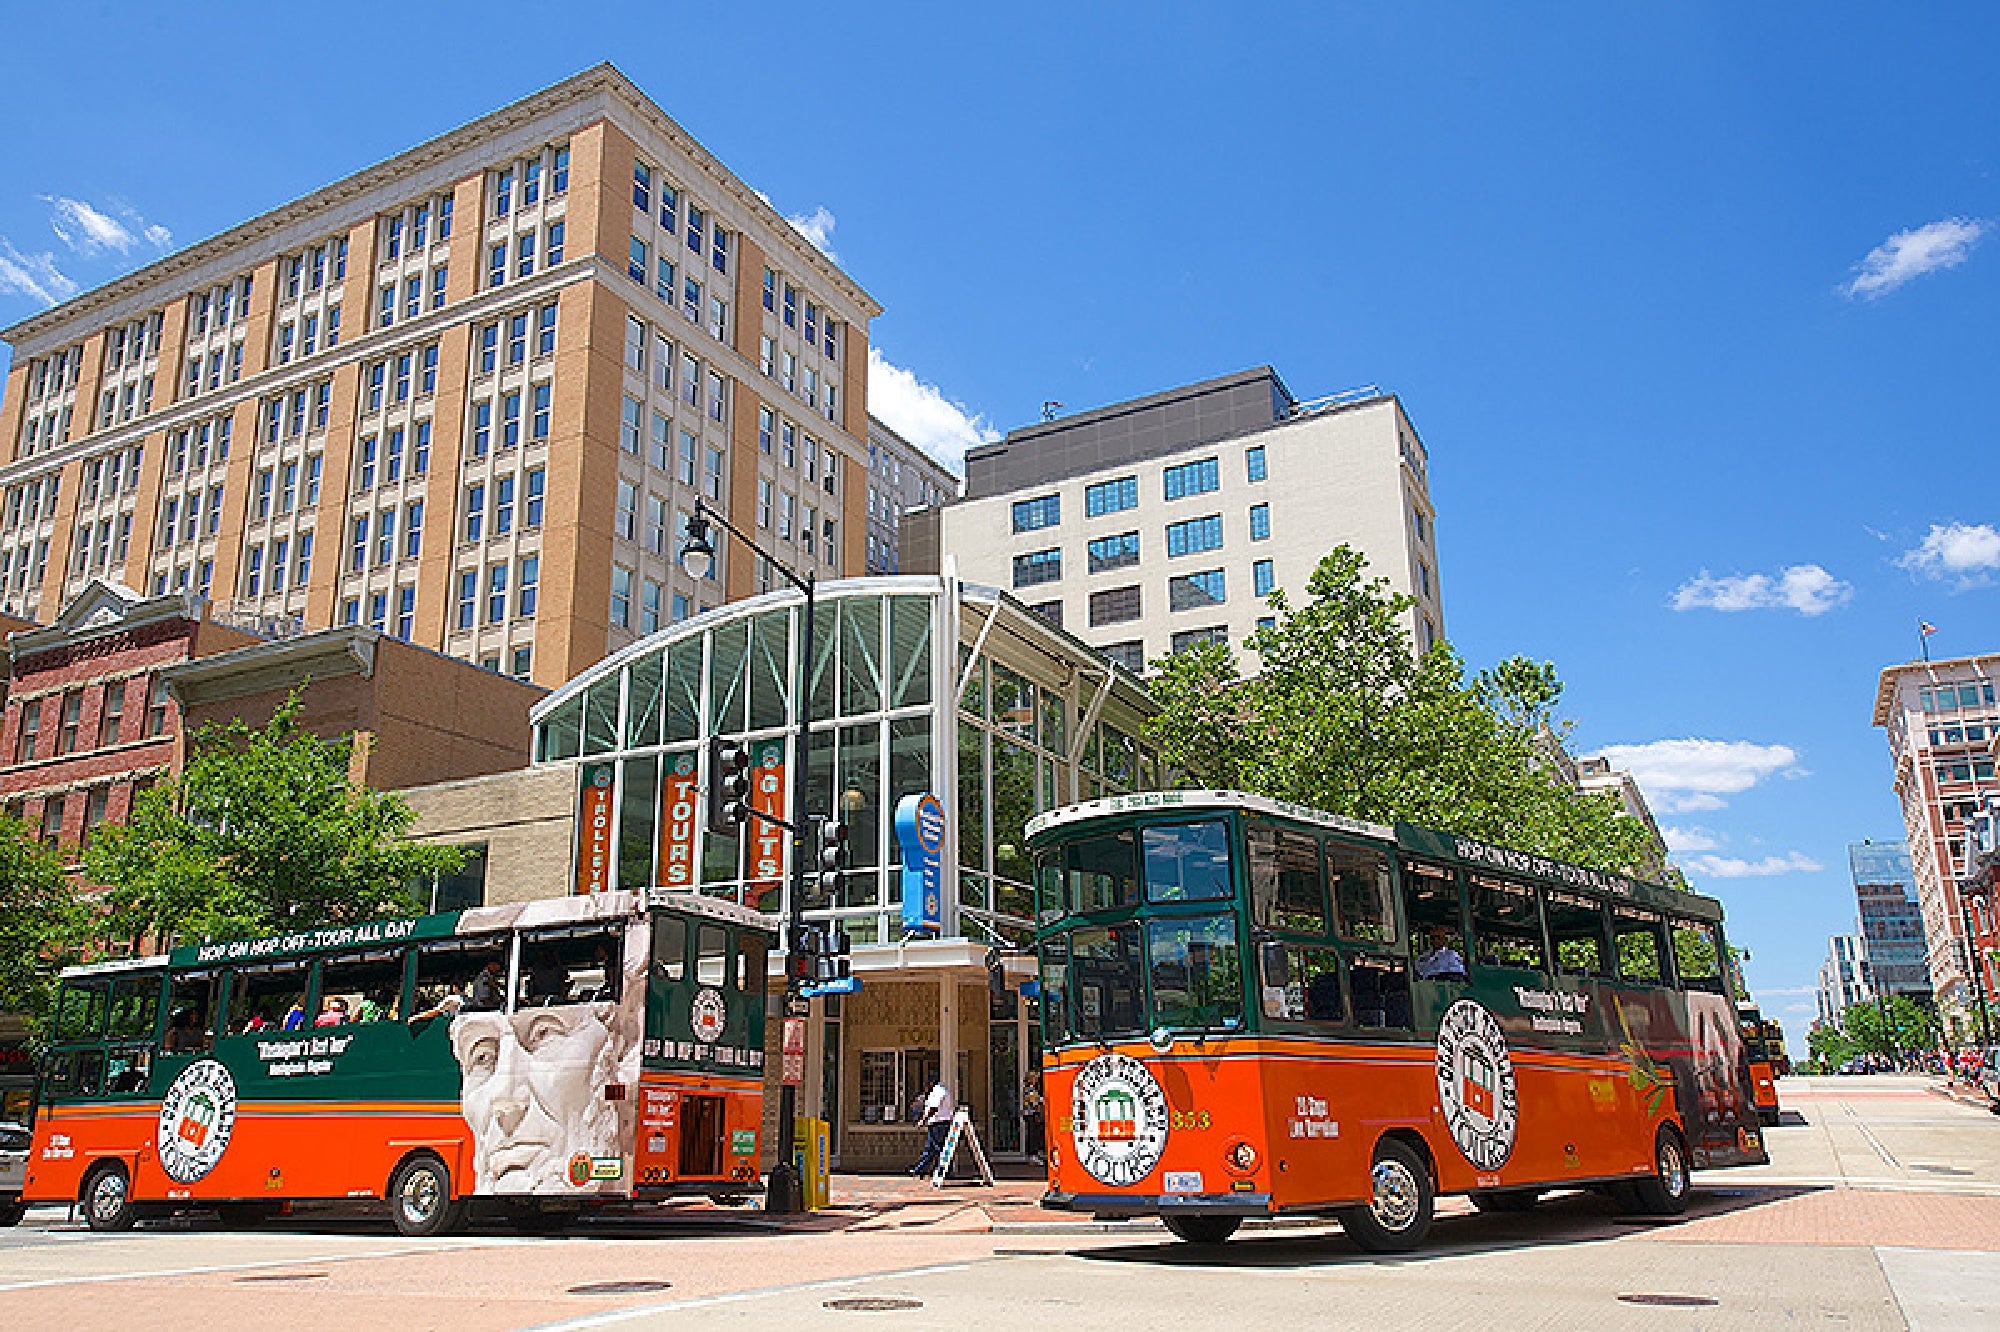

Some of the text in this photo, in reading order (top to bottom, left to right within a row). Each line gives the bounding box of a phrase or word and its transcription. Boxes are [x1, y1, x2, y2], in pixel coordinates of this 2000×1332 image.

[590, 789, 607, 894] TROLLEYS
[668, 781, 692, 883] TOURS
[757, 773, 779, 877] GIFTS
[197, 943, 226, 962] HOP
[228, 940, 249, 958] ON
[249, 936, 279, 956] HOP
[354, 923, 381, 942] ALL
[384, 918, 416, 937] DAY
[1170, 1108, 1211, 1129] 353
[1084, 1133, 1156, 1182] TOURS
